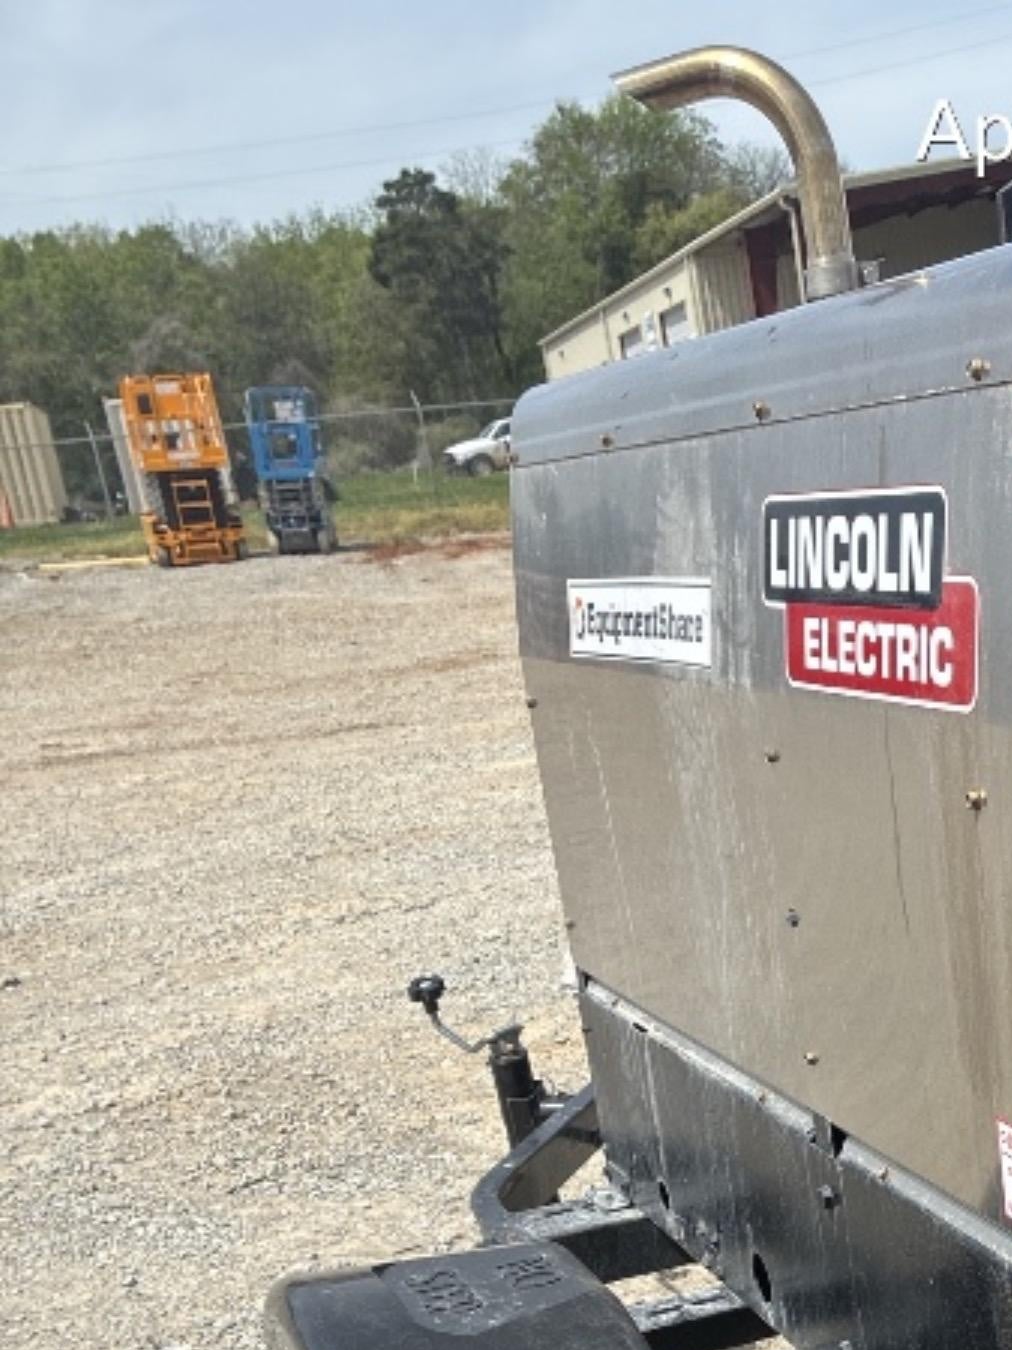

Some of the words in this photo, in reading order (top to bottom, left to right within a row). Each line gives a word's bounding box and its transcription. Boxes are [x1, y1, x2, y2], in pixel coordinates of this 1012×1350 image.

[768, 511, 934, 594] LINCOLN
[586, 601, 703, 645] EquipmentShare
[802, 616, 955, 689] ELECTRIC
